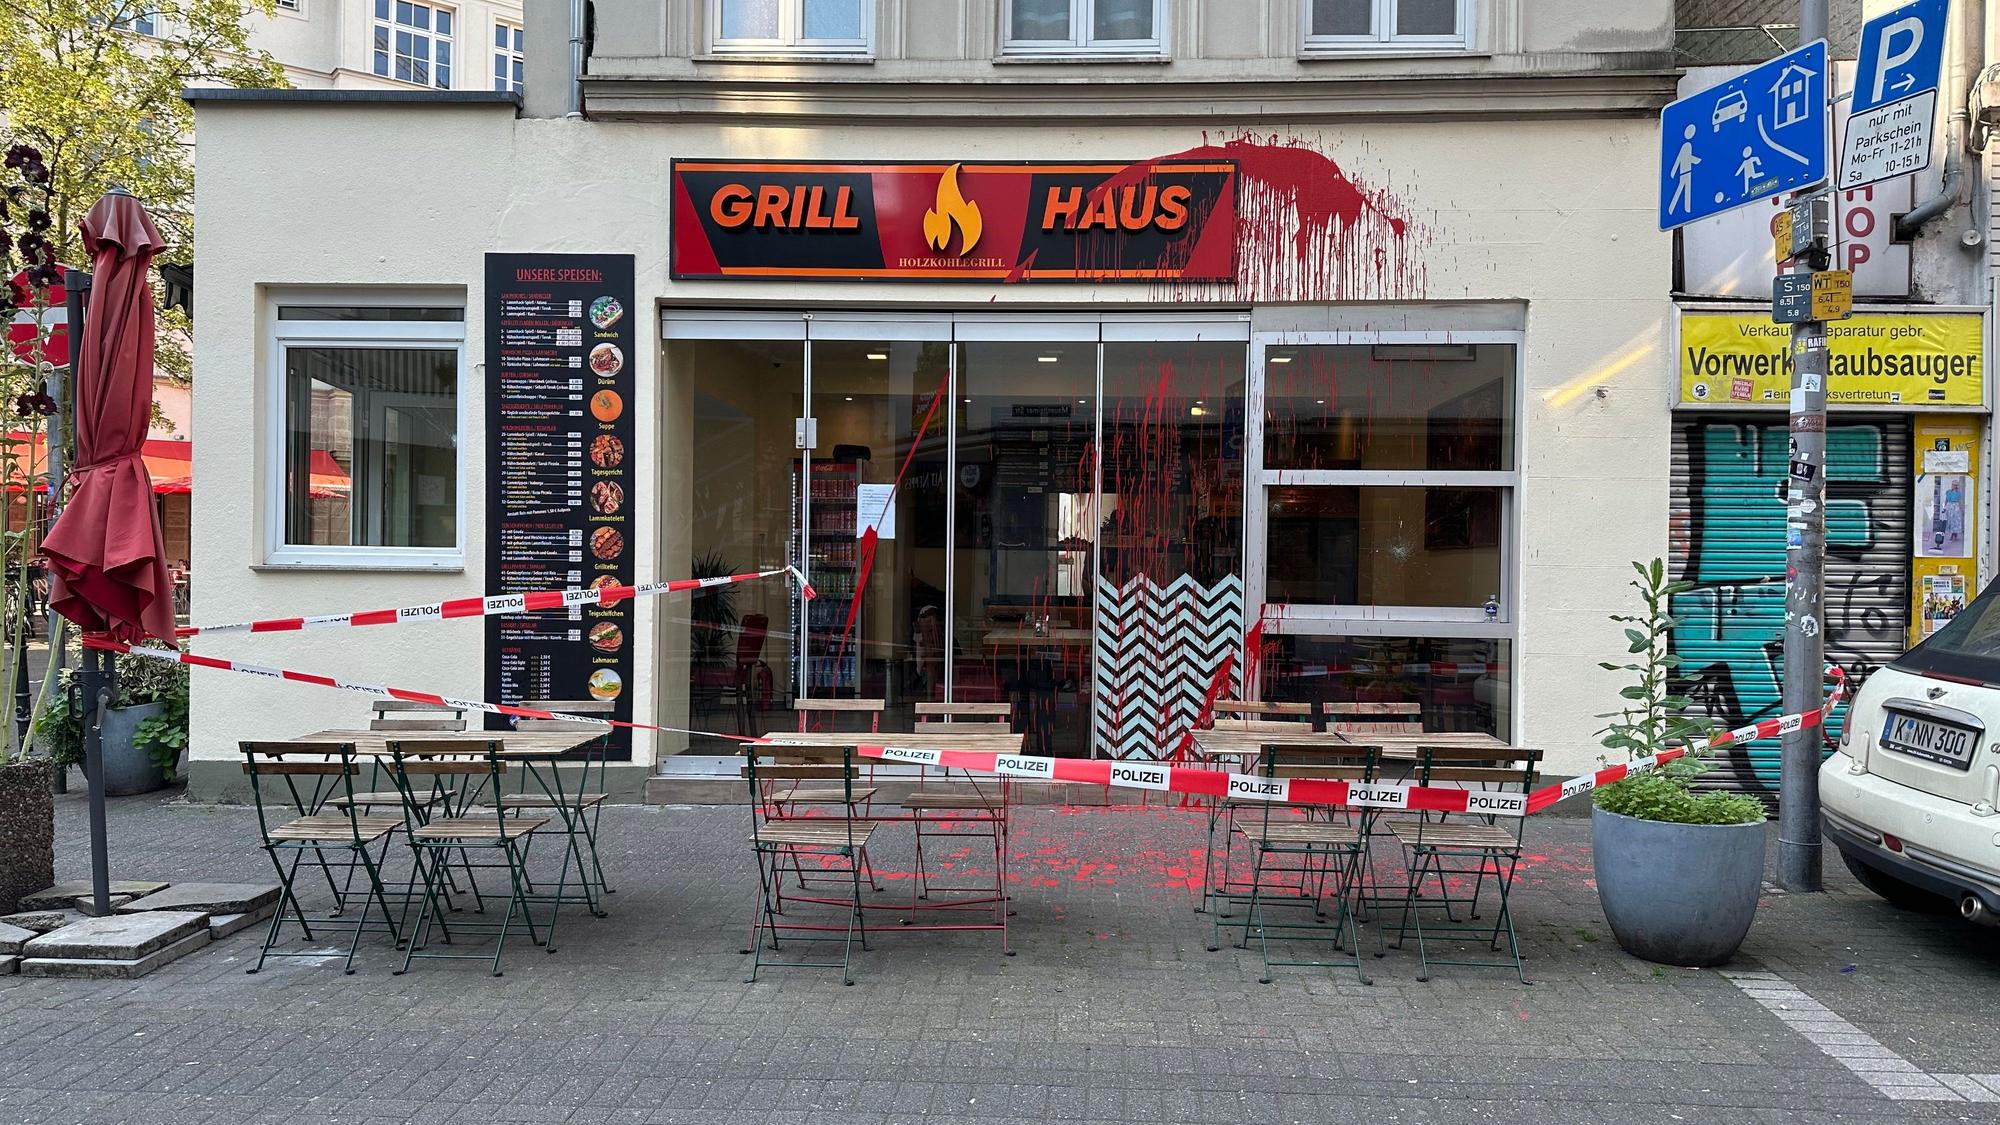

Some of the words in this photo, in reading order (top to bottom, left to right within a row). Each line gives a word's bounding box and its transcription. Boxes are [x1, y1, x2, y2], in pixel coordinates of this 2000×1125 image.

[1871, 17, 1924, 103] P
[1869, 114, 1889, 128] nur
[1893, 104, 1912, 120] mit
[1856, 121, 1921, 150] Parkschein
[1851, 148, 1884, 165] Mo-Fr
[1849, 171, 1862, 182] Sa
[710, 182, 860, 232] GRILL
[1042, 184, 1192, 233] HAUS
[898, 257, 1006, 268] HOLZKOHLEGRILL
[516, 269, 558, 281] UNSERE
[558, 269, 602, 281] SPEISEN:
[1784, 282, 1793, 292] S
[1796, 284, 1810, 292] 150
[1890, 325, 1926, 341] gebr.
[1688, 347, 1794, 376] Vorwerk
[1826, 347, 1977, 384] taubsauger
[598, 378, 616, 386] Dürüm
[591, 468, 623, 476] Tagesgericht
[400, 606, 440, 618] POLIZEI
[487, 598, 524, 610] POLIZEI
[566, 590, 599, 601] POLIZEI
[588, 610, 624, 618] Teigschiffchen
[1894, 718, 1908, 741] K
[1912, 722, 1935, 748] NN
[1934, 727, 1966, 756] 300
[884, 748, 935, 761] POLIZEI
[996, 758, 1049, 772] POLIZEI
[1112, 769, 1164, 784] POLIZEI
[1230, 781, 1283, 796] POLIZEI
[1349, 789, 1402, 804] POLIZEI
[1469, 797, 1522, 810] POLIZEI
